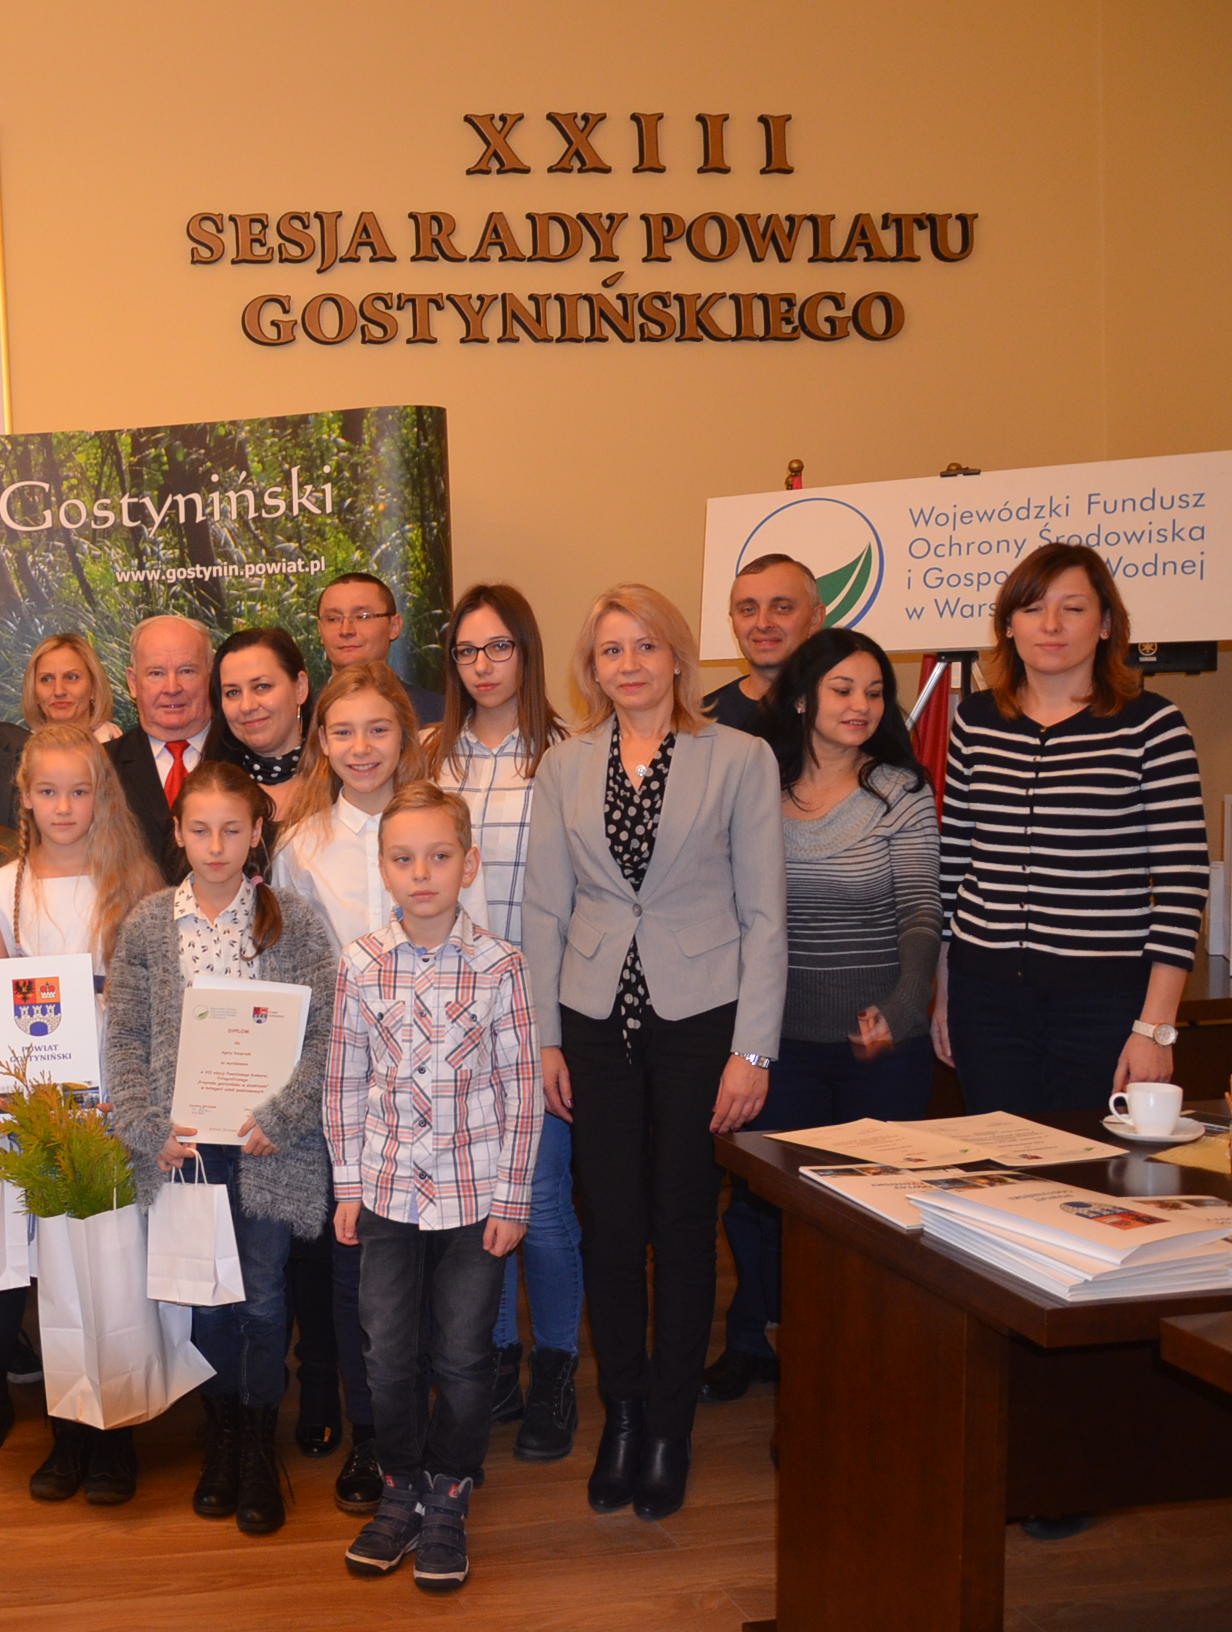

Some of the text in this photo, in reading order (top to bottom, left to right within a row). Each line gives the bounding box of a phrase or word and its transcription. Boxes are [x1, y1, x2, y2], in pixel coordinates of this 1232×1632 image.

[464, 112, 794, 175] XXIII
[186, 210, 979, 274] SESJA RADY POWIATU
[241, 270, 906, 345] GOSTYNIŃSKIEGO
[0, 464, 334, 538] Gostyniński
[909, 488, 1206, 531] Wojewódzki Fundusz
[908, 519, 1206, 560] Ochrony Środowiska
[114, 557, 327, 584] www.gostynin.powiat.pl
[907, 569, 912, 590] i
[923, 567, 1009, 592] Gospo
[905, 597, 998, 621] w Wars
